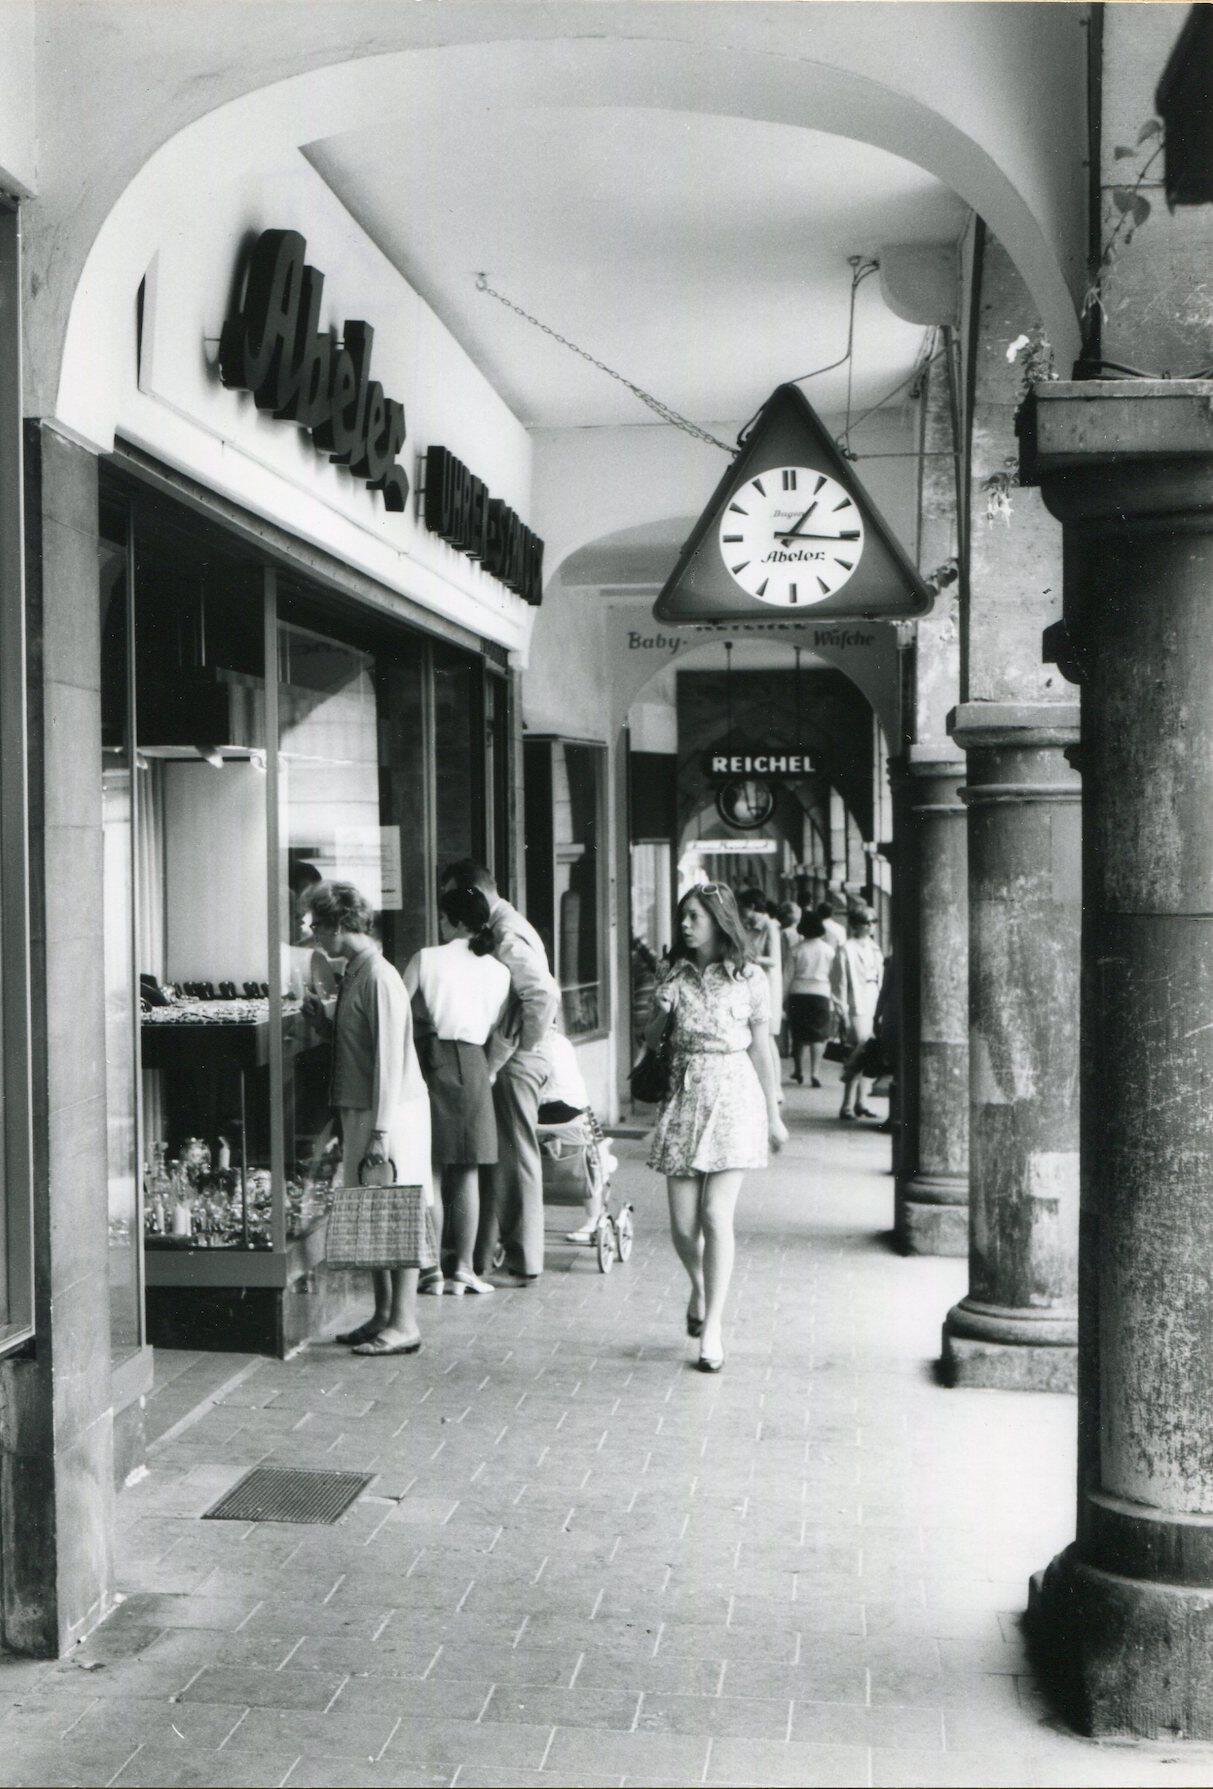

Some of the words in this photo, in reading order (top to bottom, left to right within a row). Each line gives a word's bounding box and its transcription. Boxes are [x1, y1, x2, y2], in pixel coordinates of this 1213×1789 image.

[218, 228, 410, 513] Abeler
[760, 549, 825, 563] Abeler
[711, 755, 816, 773] REICHEL
